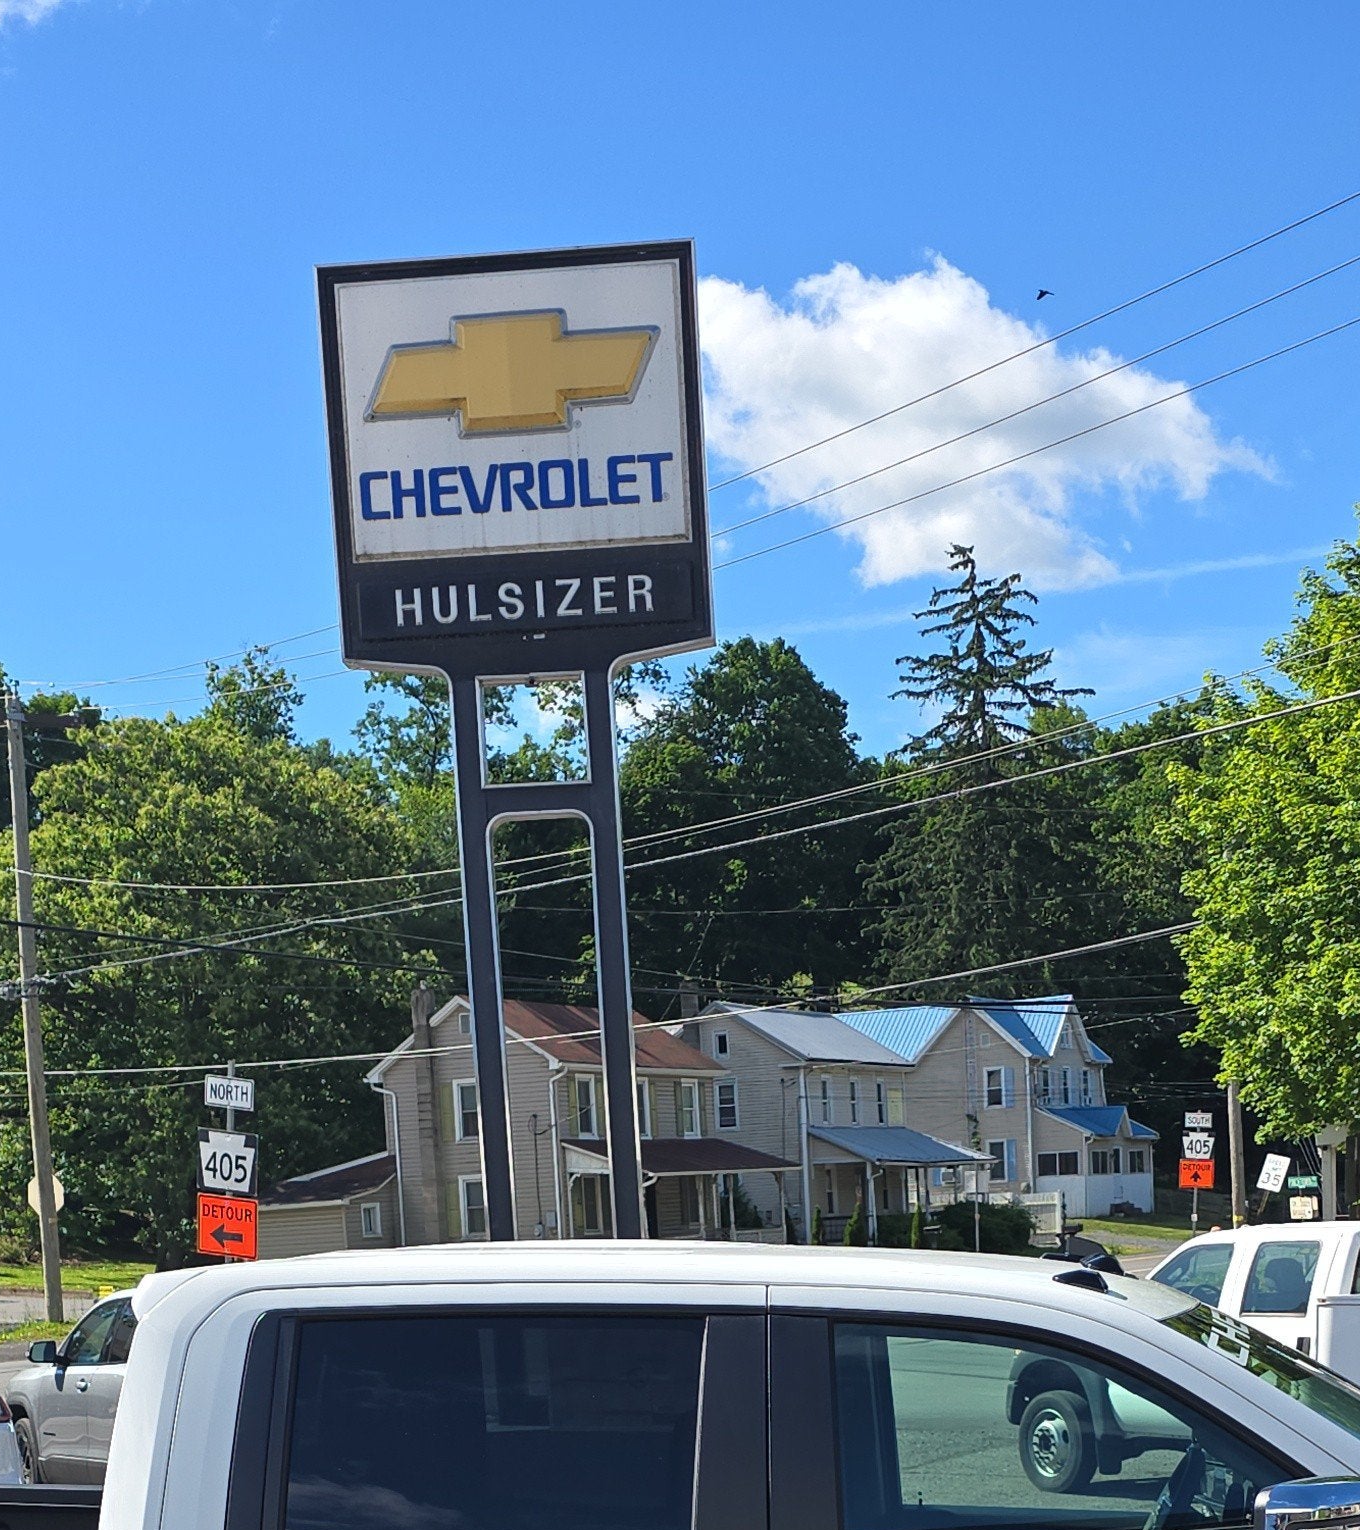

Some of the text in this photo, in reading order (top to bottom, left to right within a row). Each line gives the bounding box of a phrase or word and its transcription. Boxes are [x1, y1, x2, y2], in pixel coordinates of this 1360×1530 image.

[358, 451, 674, 520] CHEVROLET
[394, 573, 655, 628] HULSIZER
[209, 1082, 249, 1102] NORTH
[1187, 1116, 1211, 1125] SOUTH
[1186, 1139, 1211, 1155] 405
[204, 1151, 248, 1184] 405
[1182, 1163, 1211, 1171] DETOUR
[1261, 1172, 1282, 1187] 35
[201, 1203, 253, 1223] DETOUR
